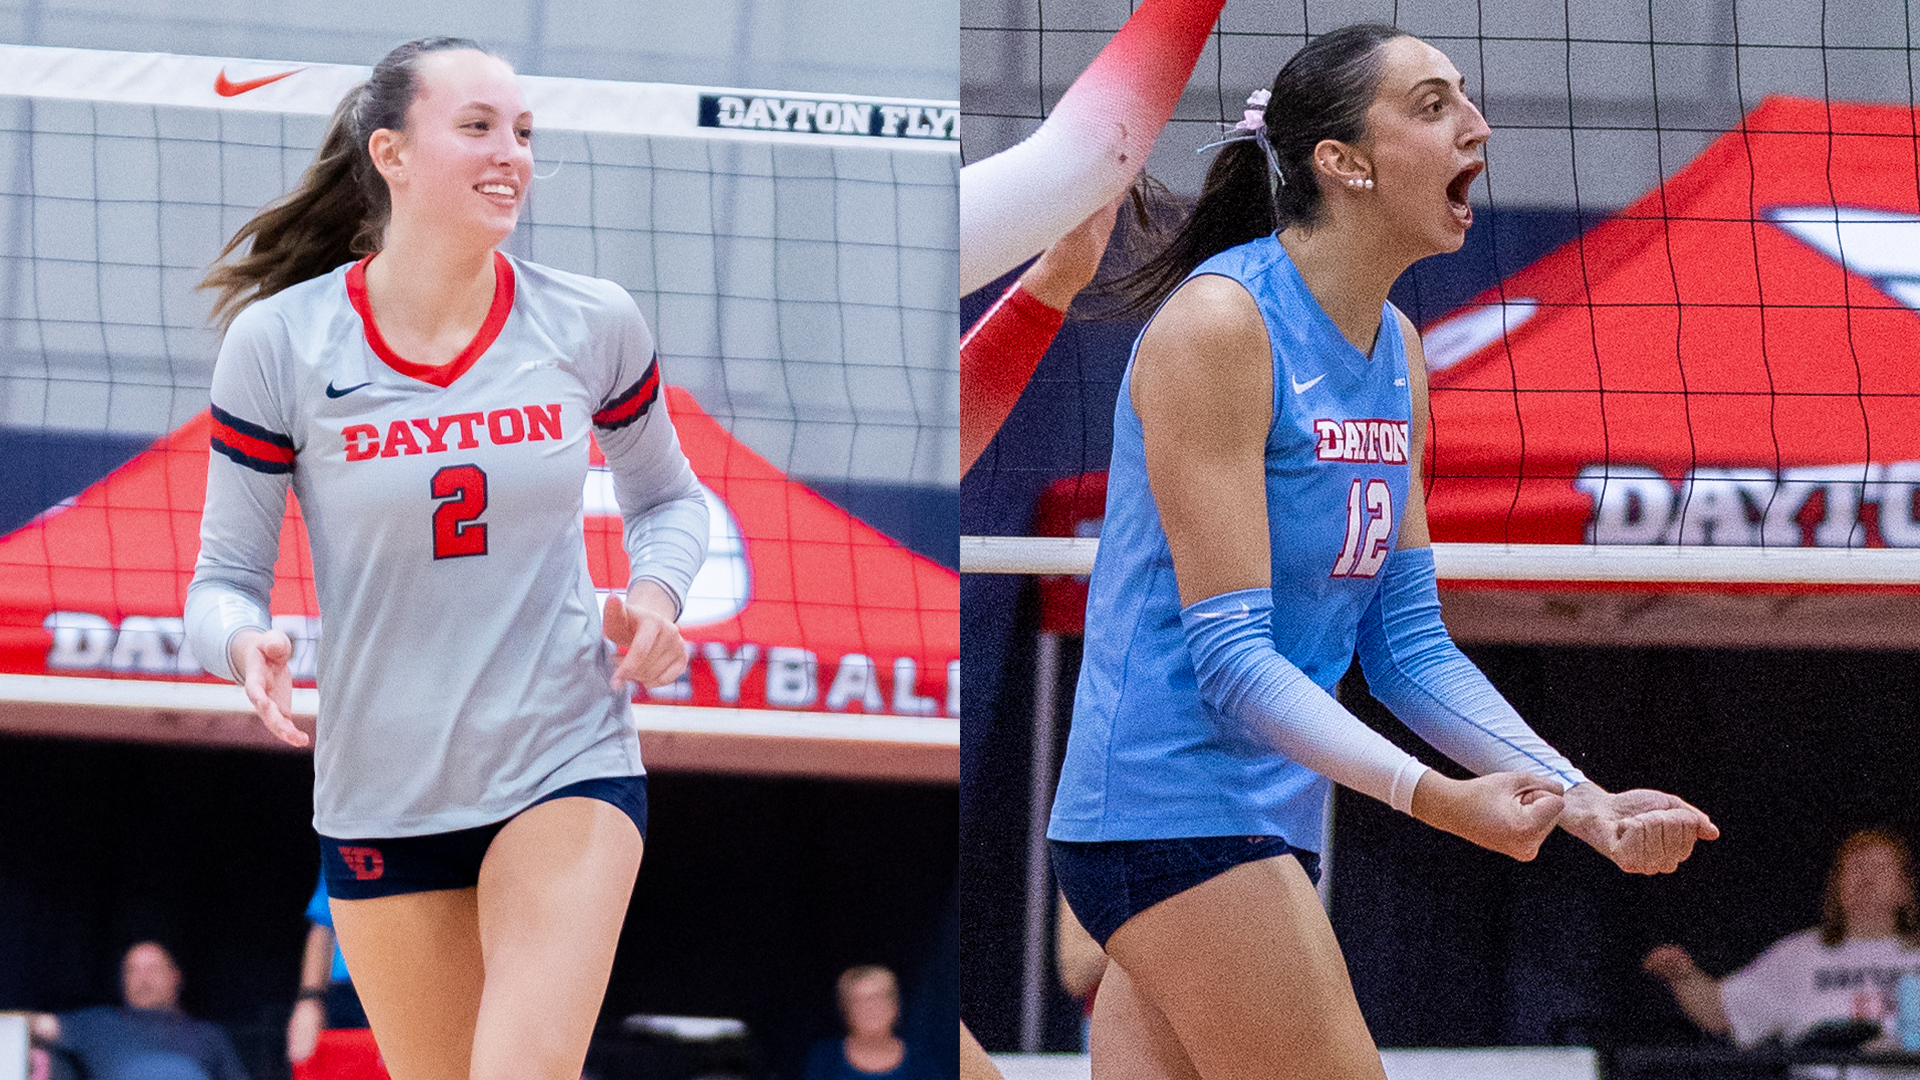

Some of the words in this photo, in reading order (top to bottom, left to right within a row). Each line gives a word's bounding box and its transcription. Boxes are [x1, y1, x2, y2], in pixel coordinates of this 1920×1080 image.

[718, 96, 872, 135] DAYTON
[341, 404, 562, 462] DAYTON
[1314, 418, 1408, 466] DAYTON
[430, 462, 488, 561] 2
[1329, 478, 1393, 578] 12
